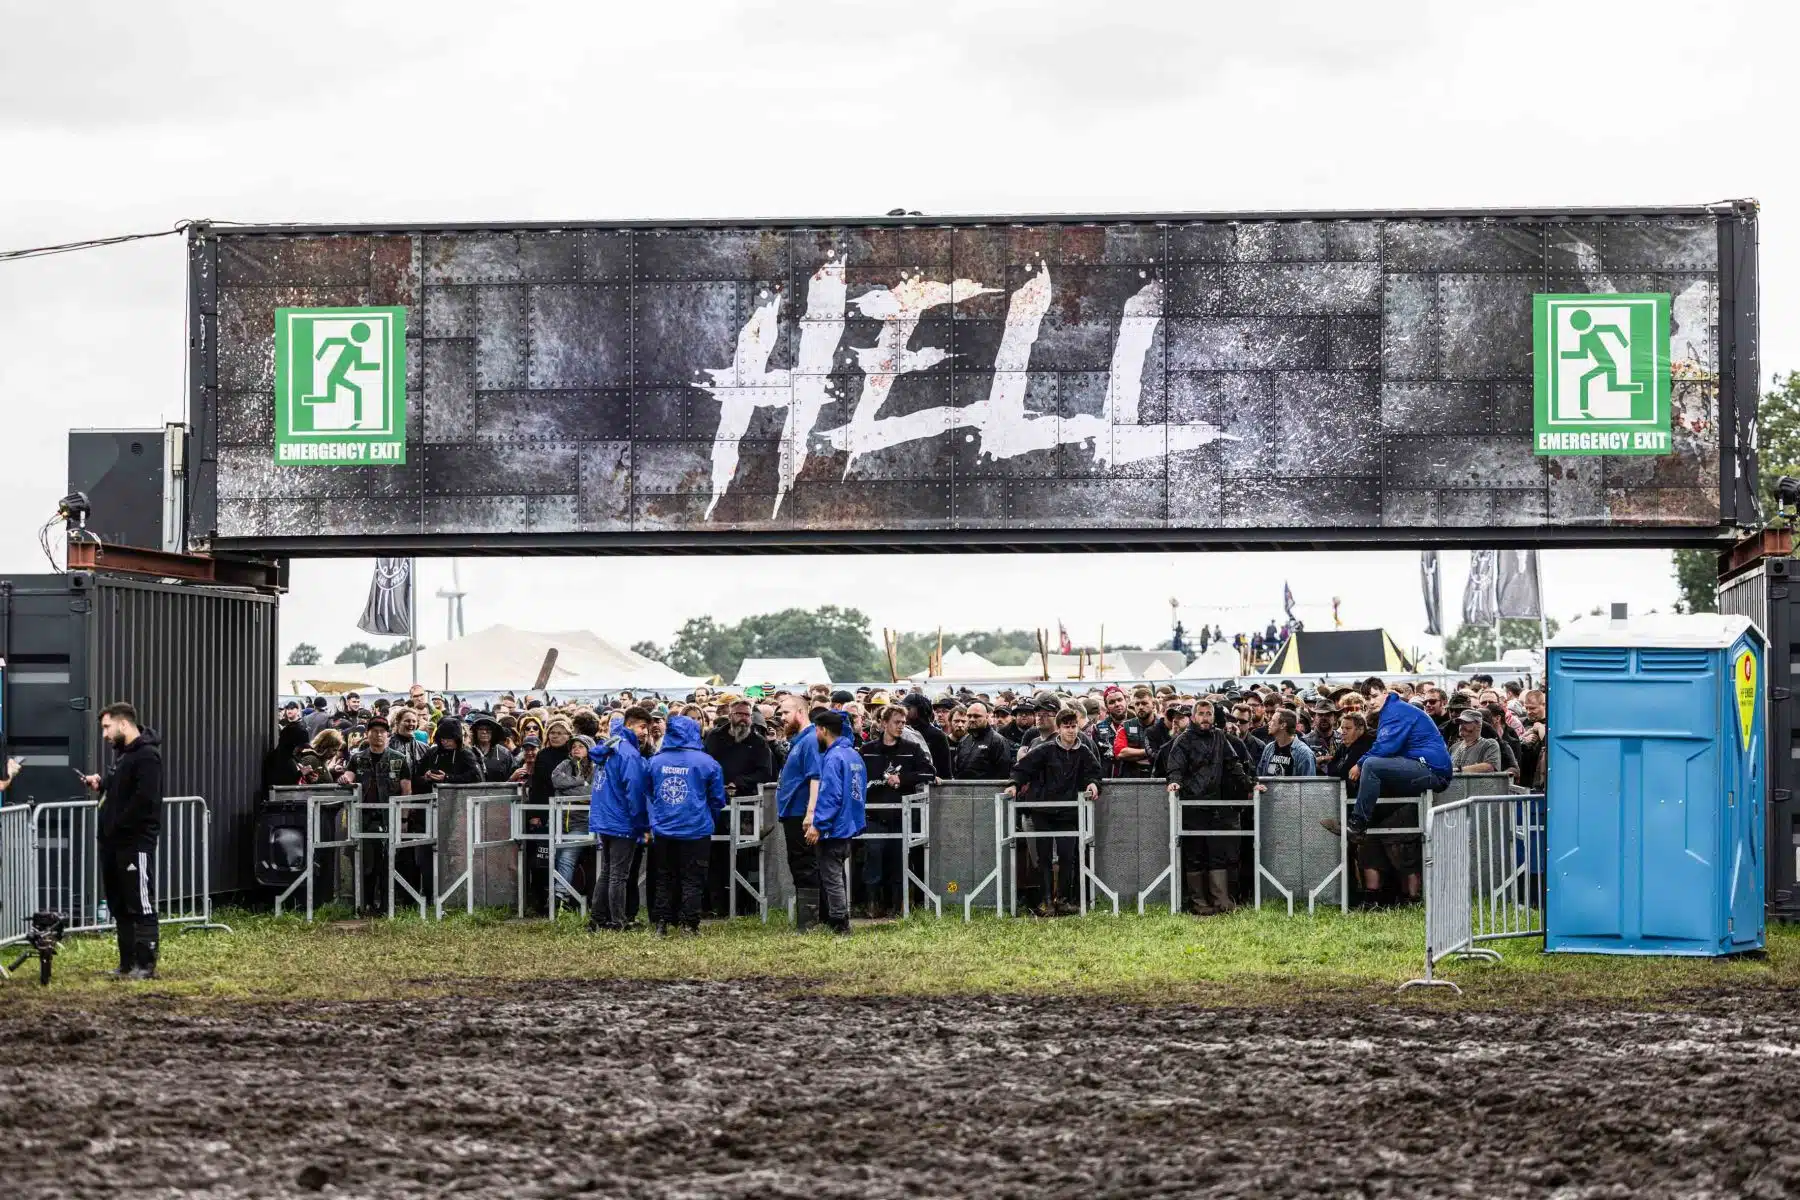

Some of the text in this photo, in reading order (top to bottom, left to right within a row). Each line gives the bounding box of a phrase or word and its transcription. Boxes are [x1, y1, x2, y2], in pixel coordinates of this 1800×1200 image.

[690, 253, 1243, 521] HELL
[1539, 432, 1666, 450] EMERGENCY EXIT
[279, 442, 401, 460] EMERGENCY EXIT
[661, 766, 689, 775] SECURITY
